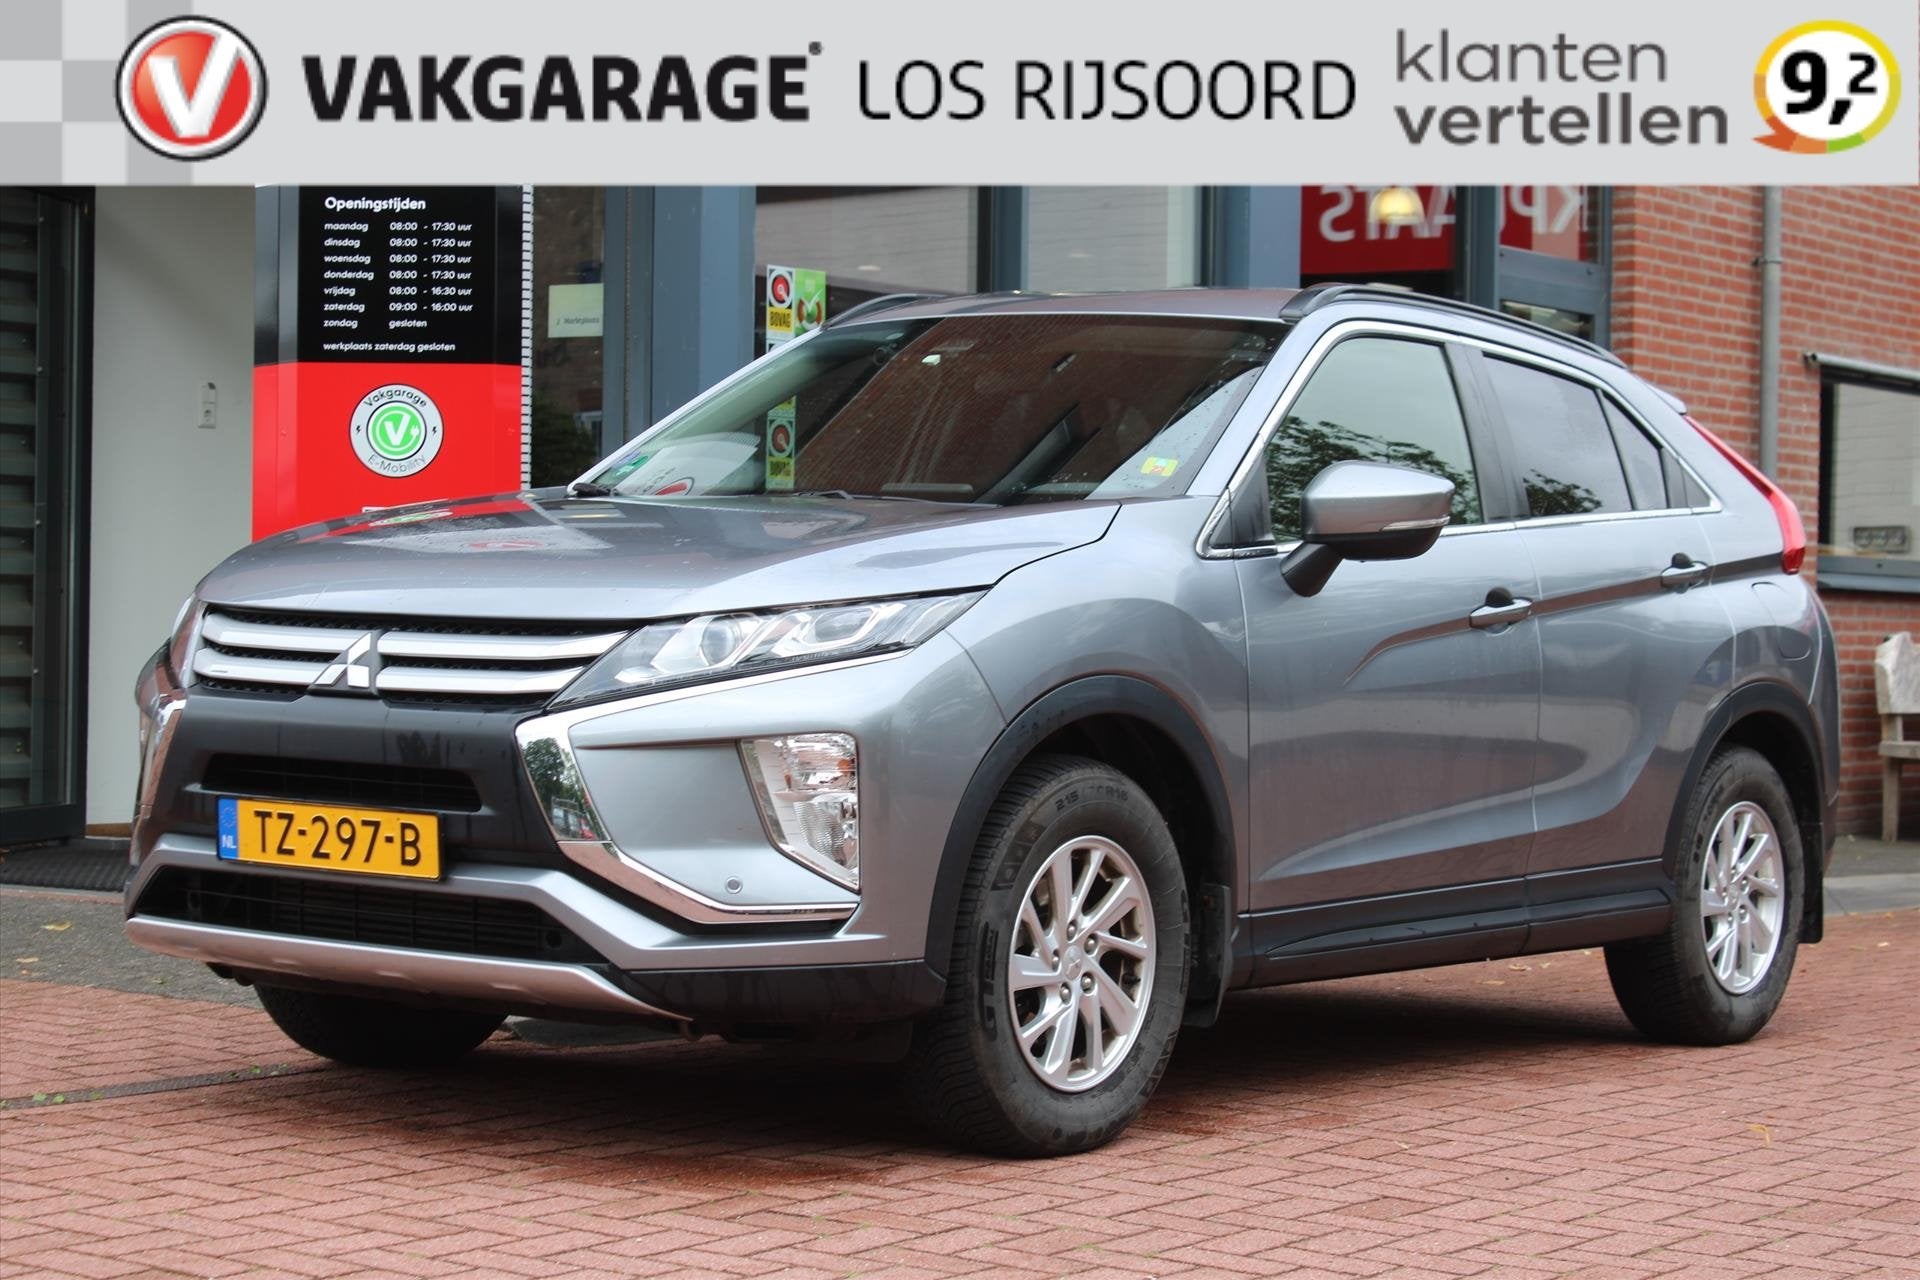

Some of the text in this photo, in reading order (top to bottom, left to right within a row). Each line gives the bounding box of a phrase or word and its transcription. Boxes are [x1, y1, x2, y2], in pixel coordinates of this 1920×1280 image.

[324, 196, 427, 213] Openingstijden
[323, 221, 369, 233] maandag
[389, 222, 418, 232] 08:00
[431, 222, 457, 232] 17:30
[457, 224, 473, 232] uur
[323, 237, 361, 249] dinsdag
[389, 238, 418, 248] 08:00
[431, 238, 457, 248] 17:30
[457, 240, 473, 248] uur
[323, 253, 372, 265] woensdag
[389, 254, 418, 264] 08:00
[431, 254, 457, 264] 17:30
[457, 256, 473, 264] uur
[323, 269, 375, 281] donderdag
[389, 270, 418, 280] 08:00
[431, 270, 457, 280] 17:30
[457, 272, 473, 280] uur
[323, 285, 356, 297] vrijdag
[389, 286, 418, 296] 08:00
[431, 286, 457, 296] 16:30
[457, 288, 473, 296] uur
[323, 301, 366, 313] zaterdag
[389, 302, 418, 312] 09:00
[431, 302, 457, 312] 16:00
[457, 304, 473, 312] uur
[323, 317, 428, 330] zondag gesloten
[322, 341, 456, 354] werkplaats zaterdag gesloten
[364, 388, 427, 407] Vakgarage
[367, 453, 426, 473] E-Mobility
[221, 834, 237, 849] NL
[253, 809, 422, 868] TZ-297-B
